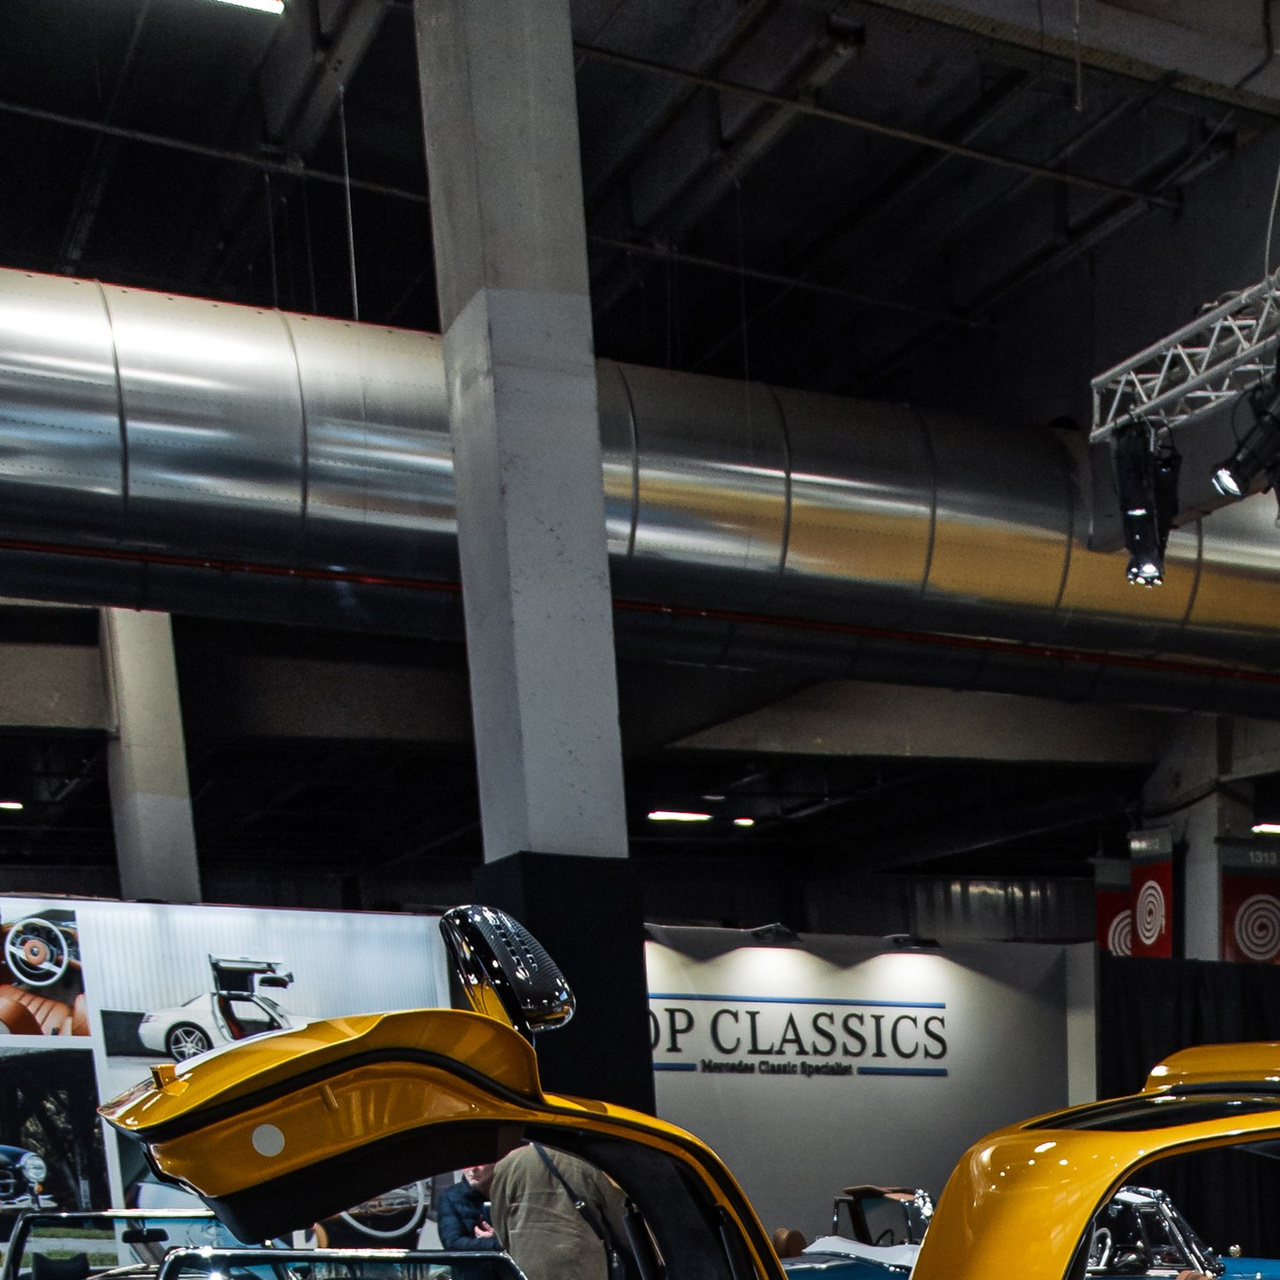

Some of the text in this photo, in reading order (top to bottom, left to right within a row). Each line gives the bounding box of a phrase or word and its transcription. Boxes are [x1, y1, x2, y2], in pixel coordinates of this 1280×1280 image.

[1248, 851, 1277, 865] 1313
[710, 1009, 948, 1060] CLASSICS
[758, 1060, 798, 1075] Classic
[800, 1061, 853, 1078] Specialist
